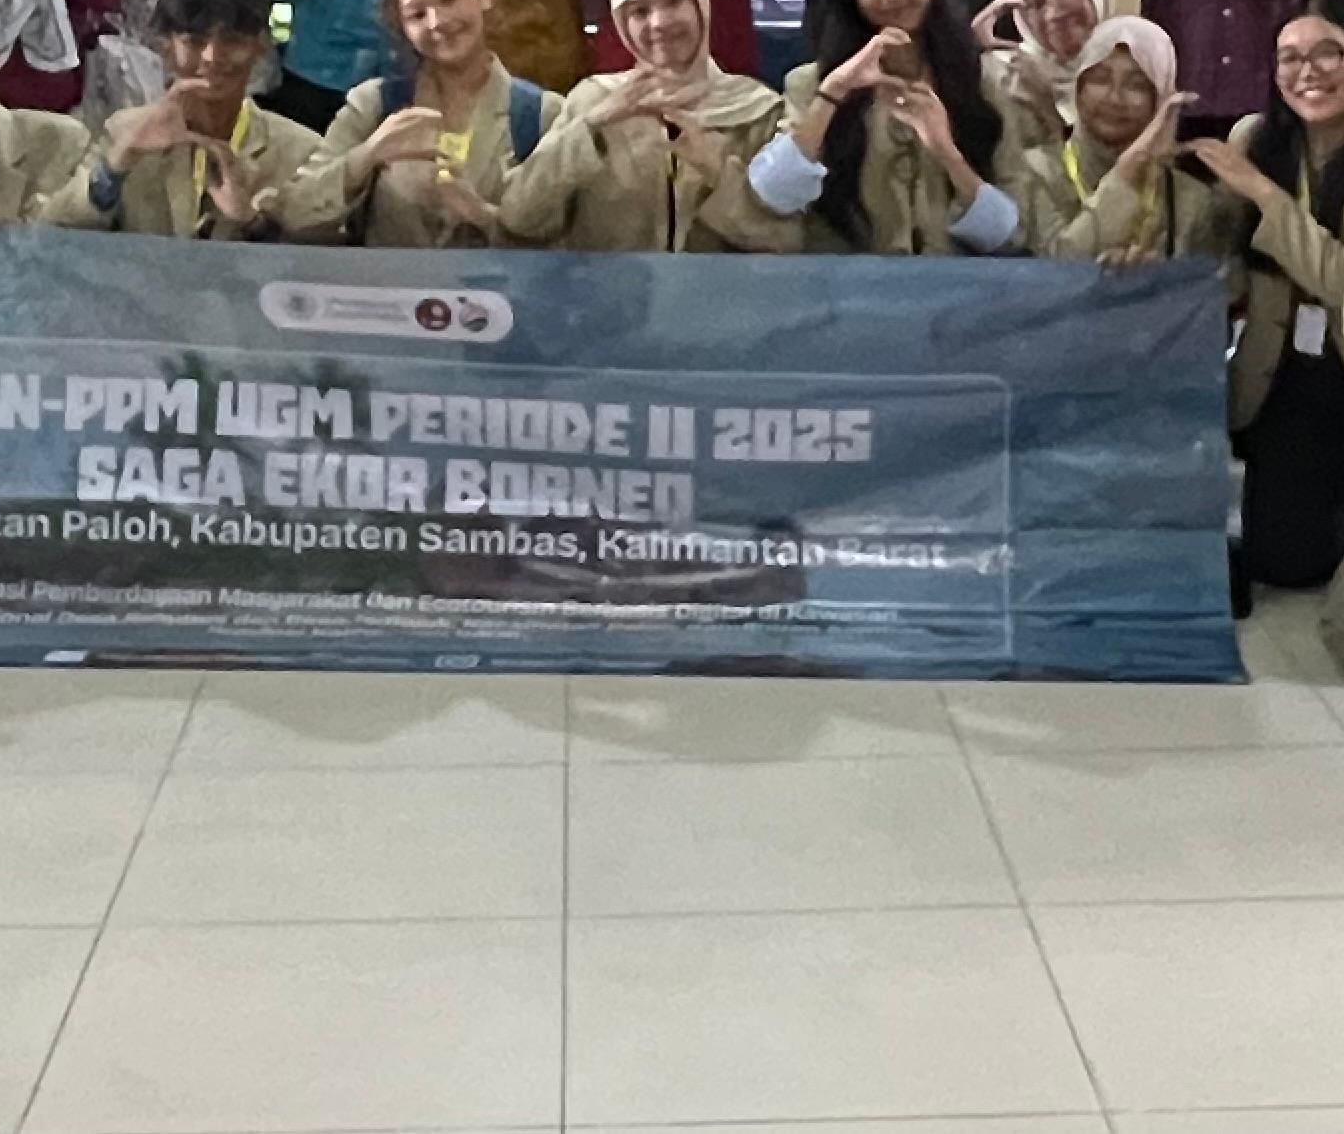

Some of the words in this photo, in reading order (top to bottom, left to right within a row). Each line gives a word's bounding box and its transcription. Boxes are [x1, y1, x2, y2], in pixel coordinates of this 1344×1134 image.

[215, 380, 354, 440] UGM
[369, 391, 633, 458] PERIODE
[647, 404, 696, 461] II
[712, 407, 874, 463] 2025
[77, 444, 246, 507] SAGA
[264, 451, 429, 514] EKOR
[444, 457, 693, 528] BORNEO
[62, 509, 182, 548] Paloh,
[190, 513, 407, 555] Kabupaten
[418, 521, 586, 564] Sambas,
[597, 529, 826, 567] Kalimantan
[837, 537, 948, 568] Barat
